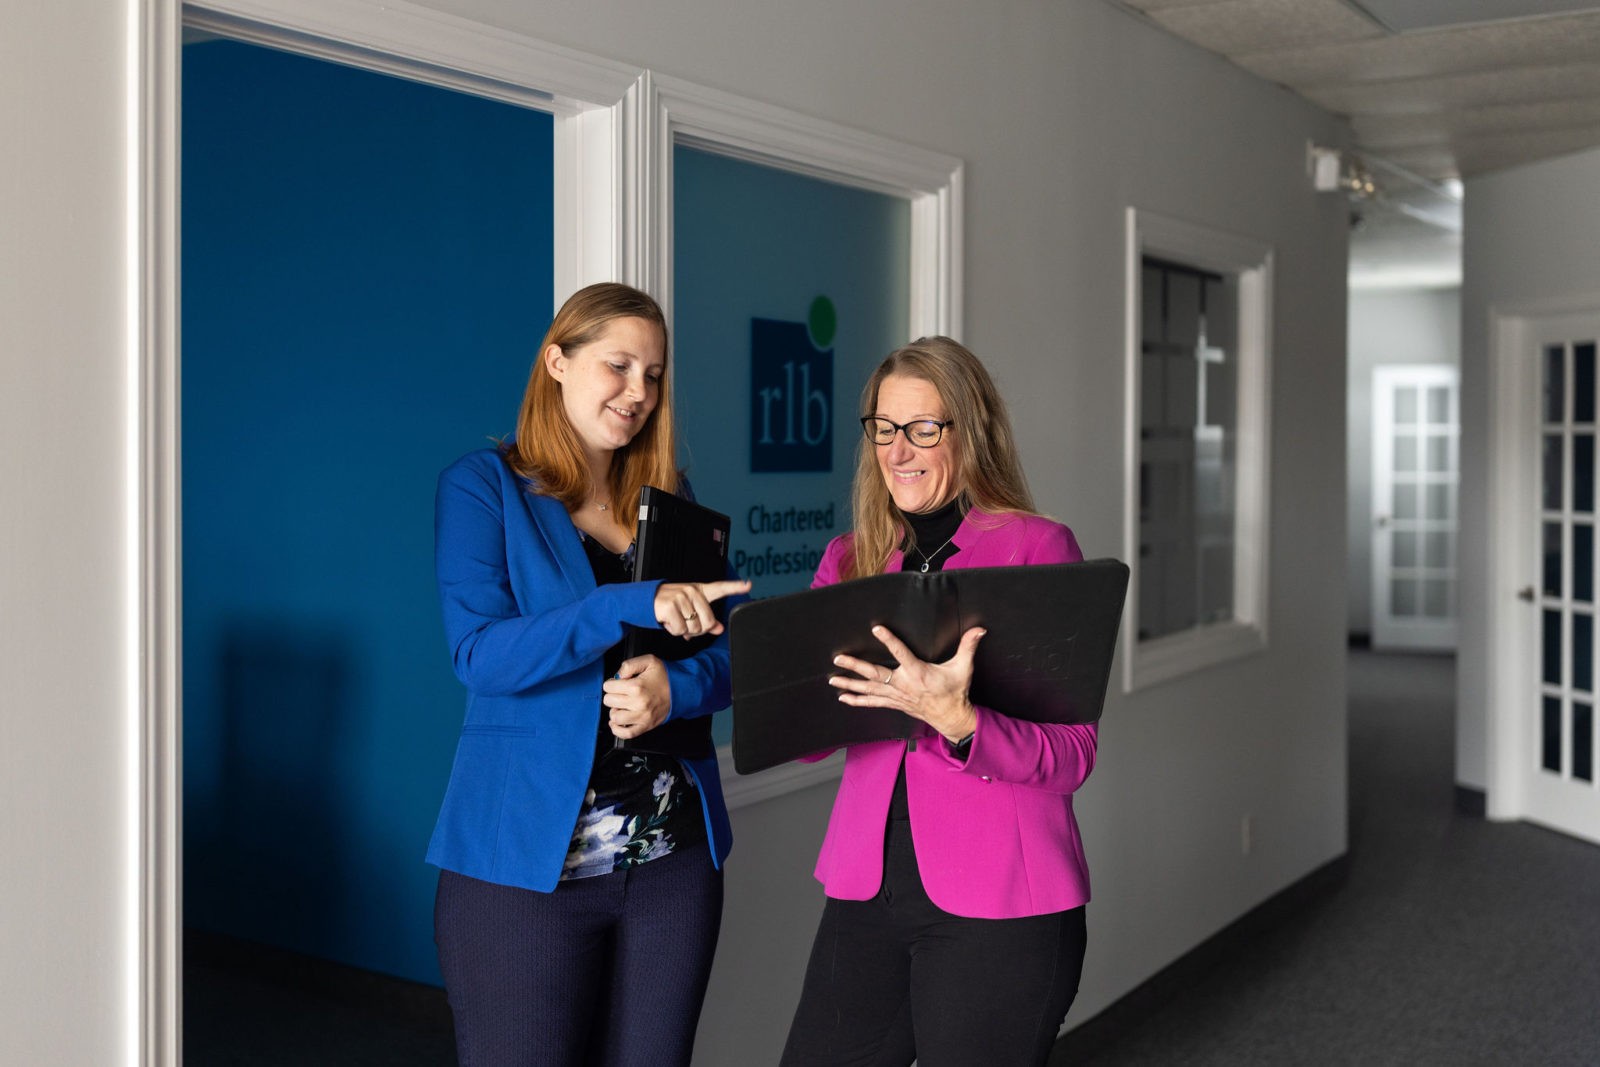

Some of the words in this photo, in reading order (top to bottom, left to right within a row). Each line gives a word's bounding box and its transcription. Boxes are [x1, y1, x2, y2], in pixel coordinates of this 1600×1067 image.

[759, 361, 828, 445] rlb
[748, 503, 834, 533] Chartered
[735, 545, 824, 576] Professio
